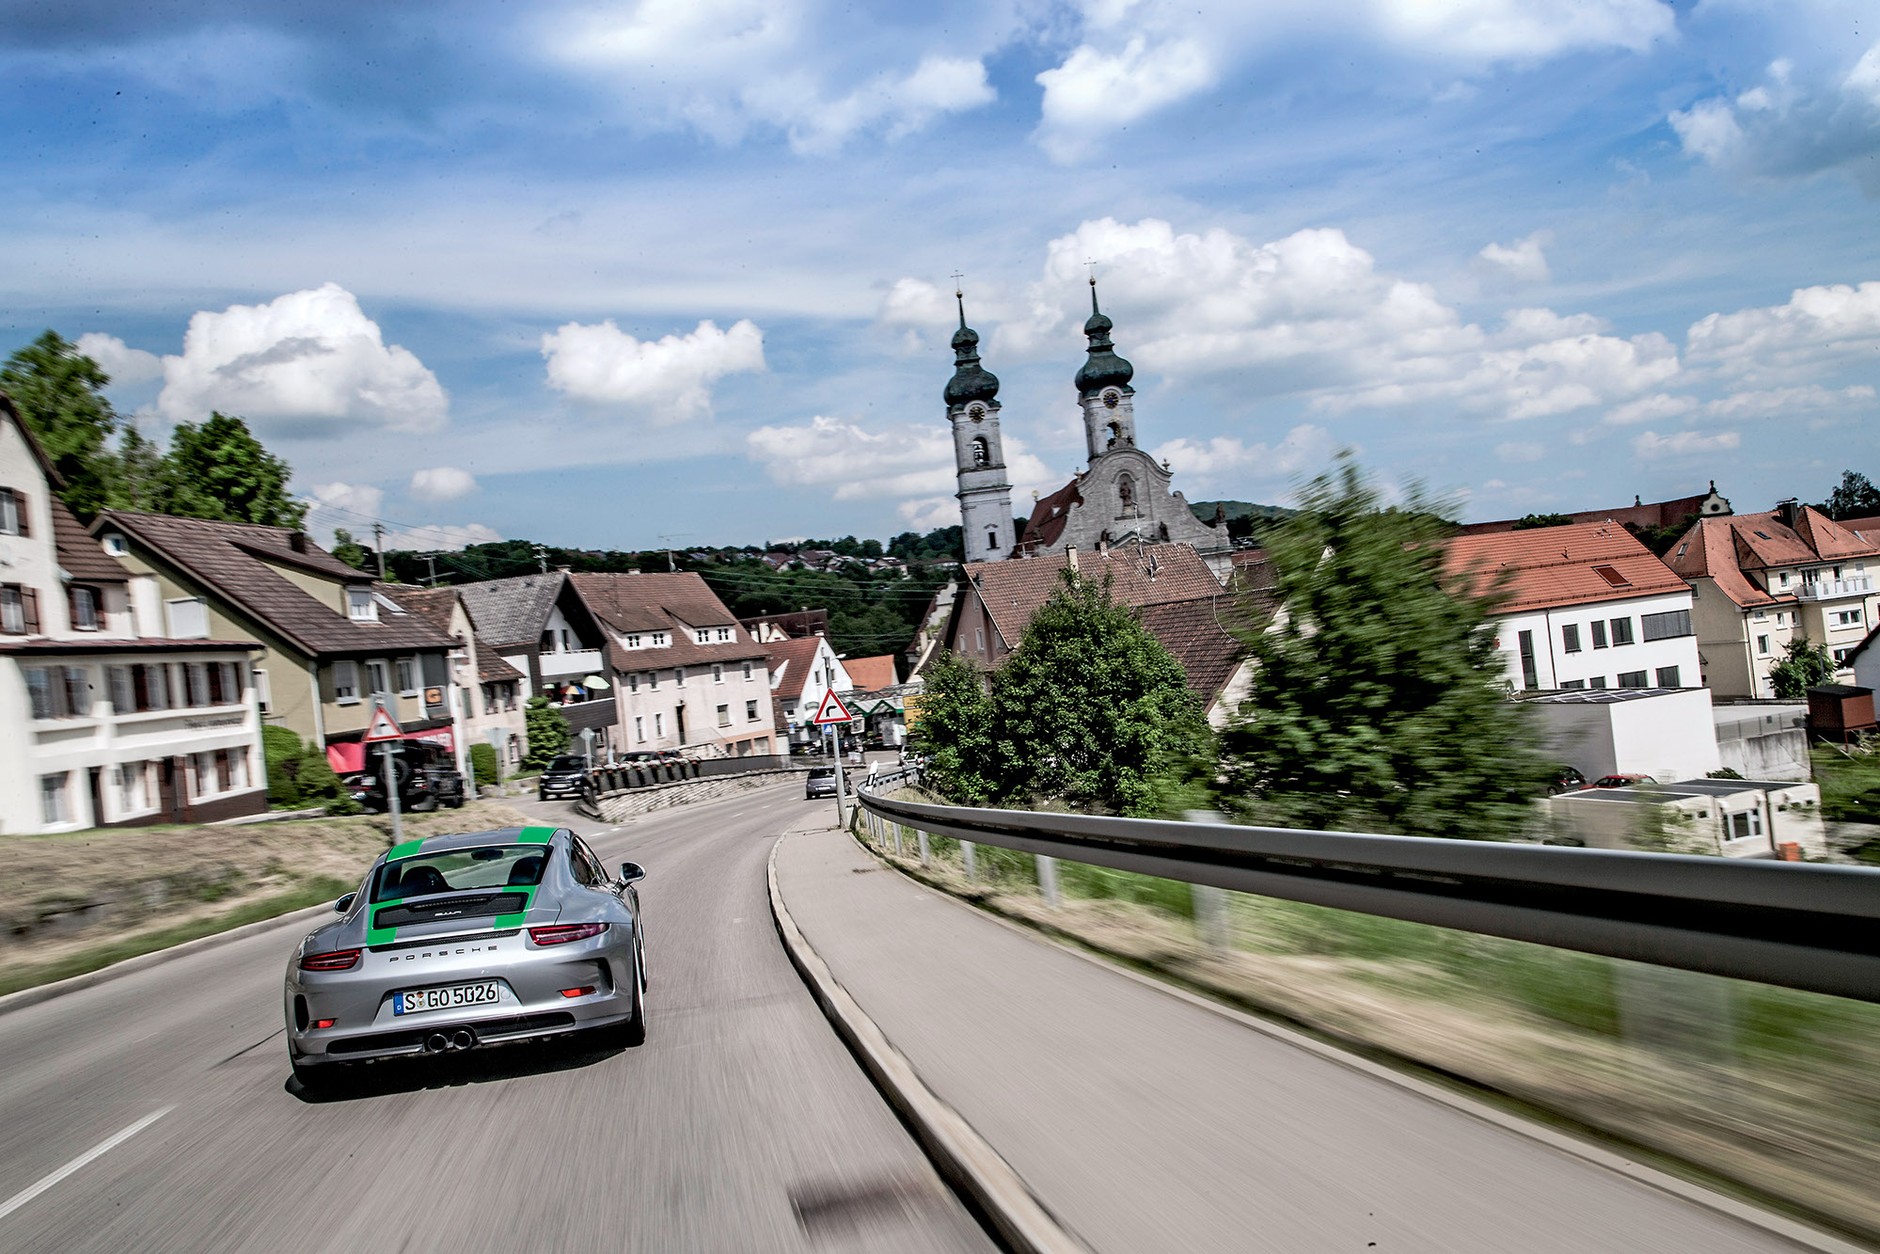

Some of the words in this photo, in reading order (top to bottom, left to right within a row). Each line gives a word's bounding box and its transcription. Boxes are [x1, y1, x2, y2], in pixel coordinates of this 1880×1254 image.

[389, 945, 498, 962] PORSCHE
[405, 993, 416, 1010] S
[427, 989, 450, 1008] GO
[453, 983, 496, 1004] 5026
